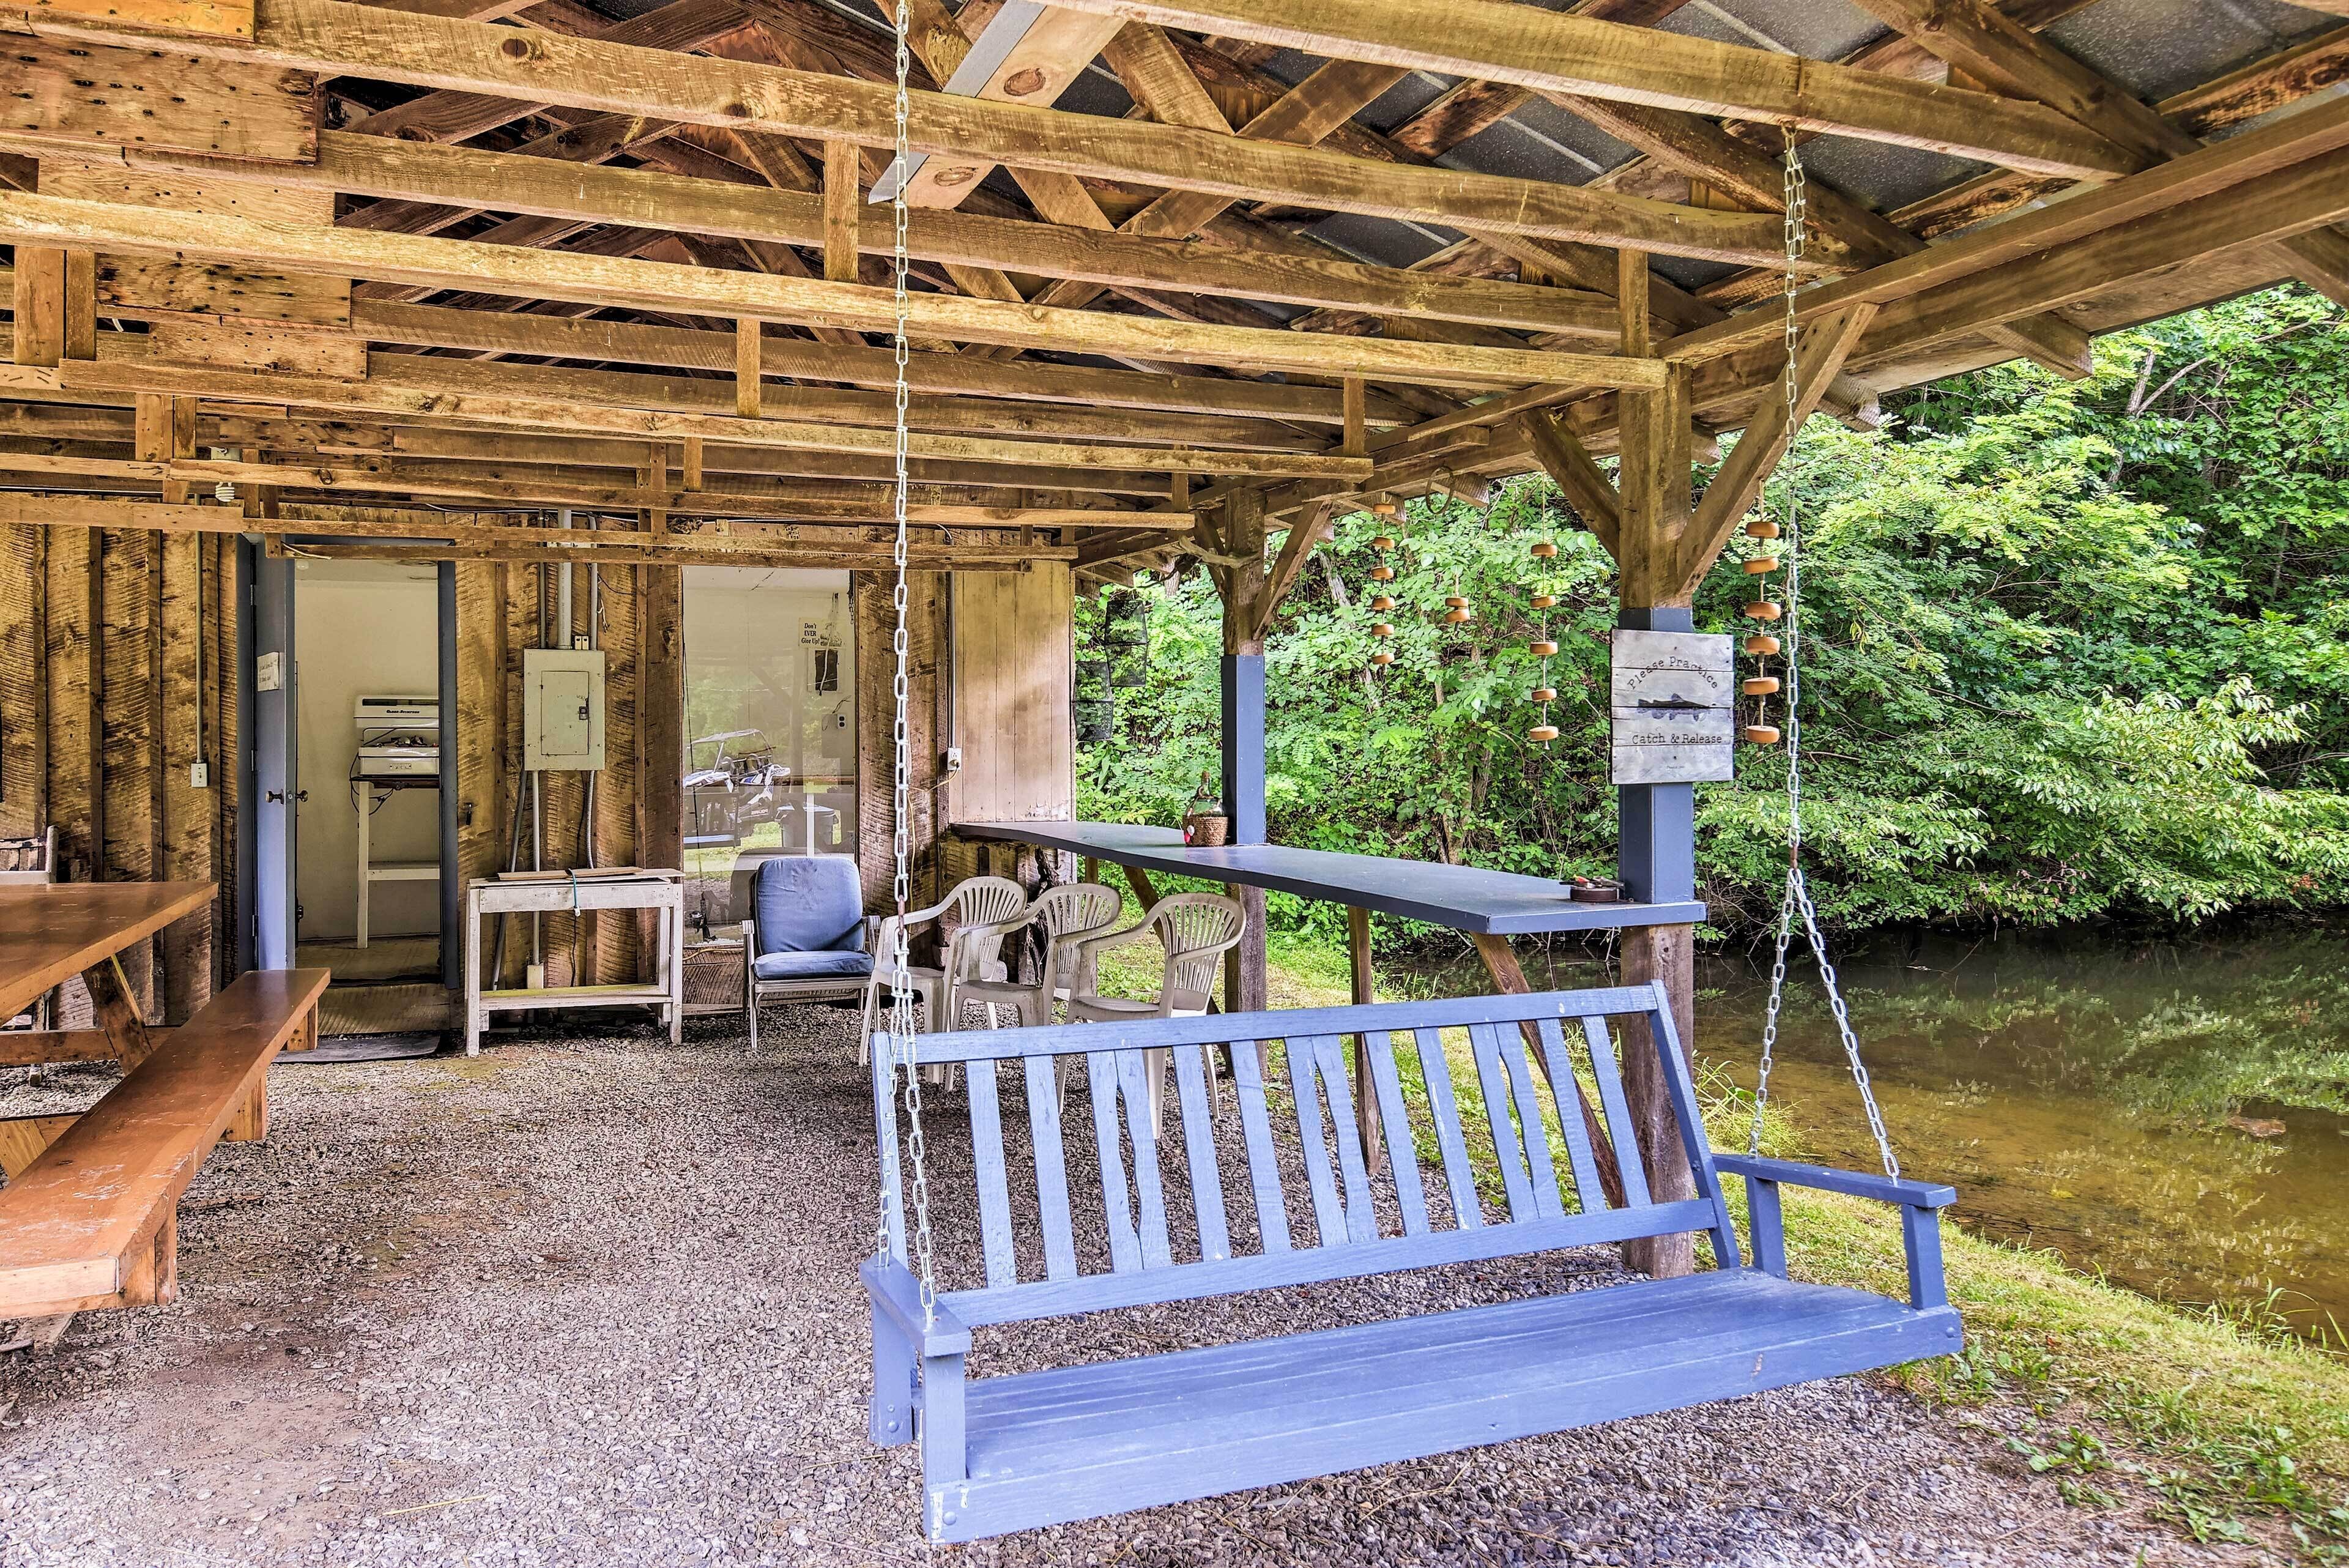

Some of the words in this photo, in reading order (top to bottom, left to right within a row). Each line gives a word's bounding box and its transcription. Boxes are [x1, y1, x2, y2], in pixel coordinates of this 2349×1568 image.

[1627, 660, 1664, 689] Please
[1669, 655, 1718, 689] Practice
[1631, 733, 1666, 745] Catch
[1671, 734, 1680, 744] &
[1682, 734, 1723, 744] Release
